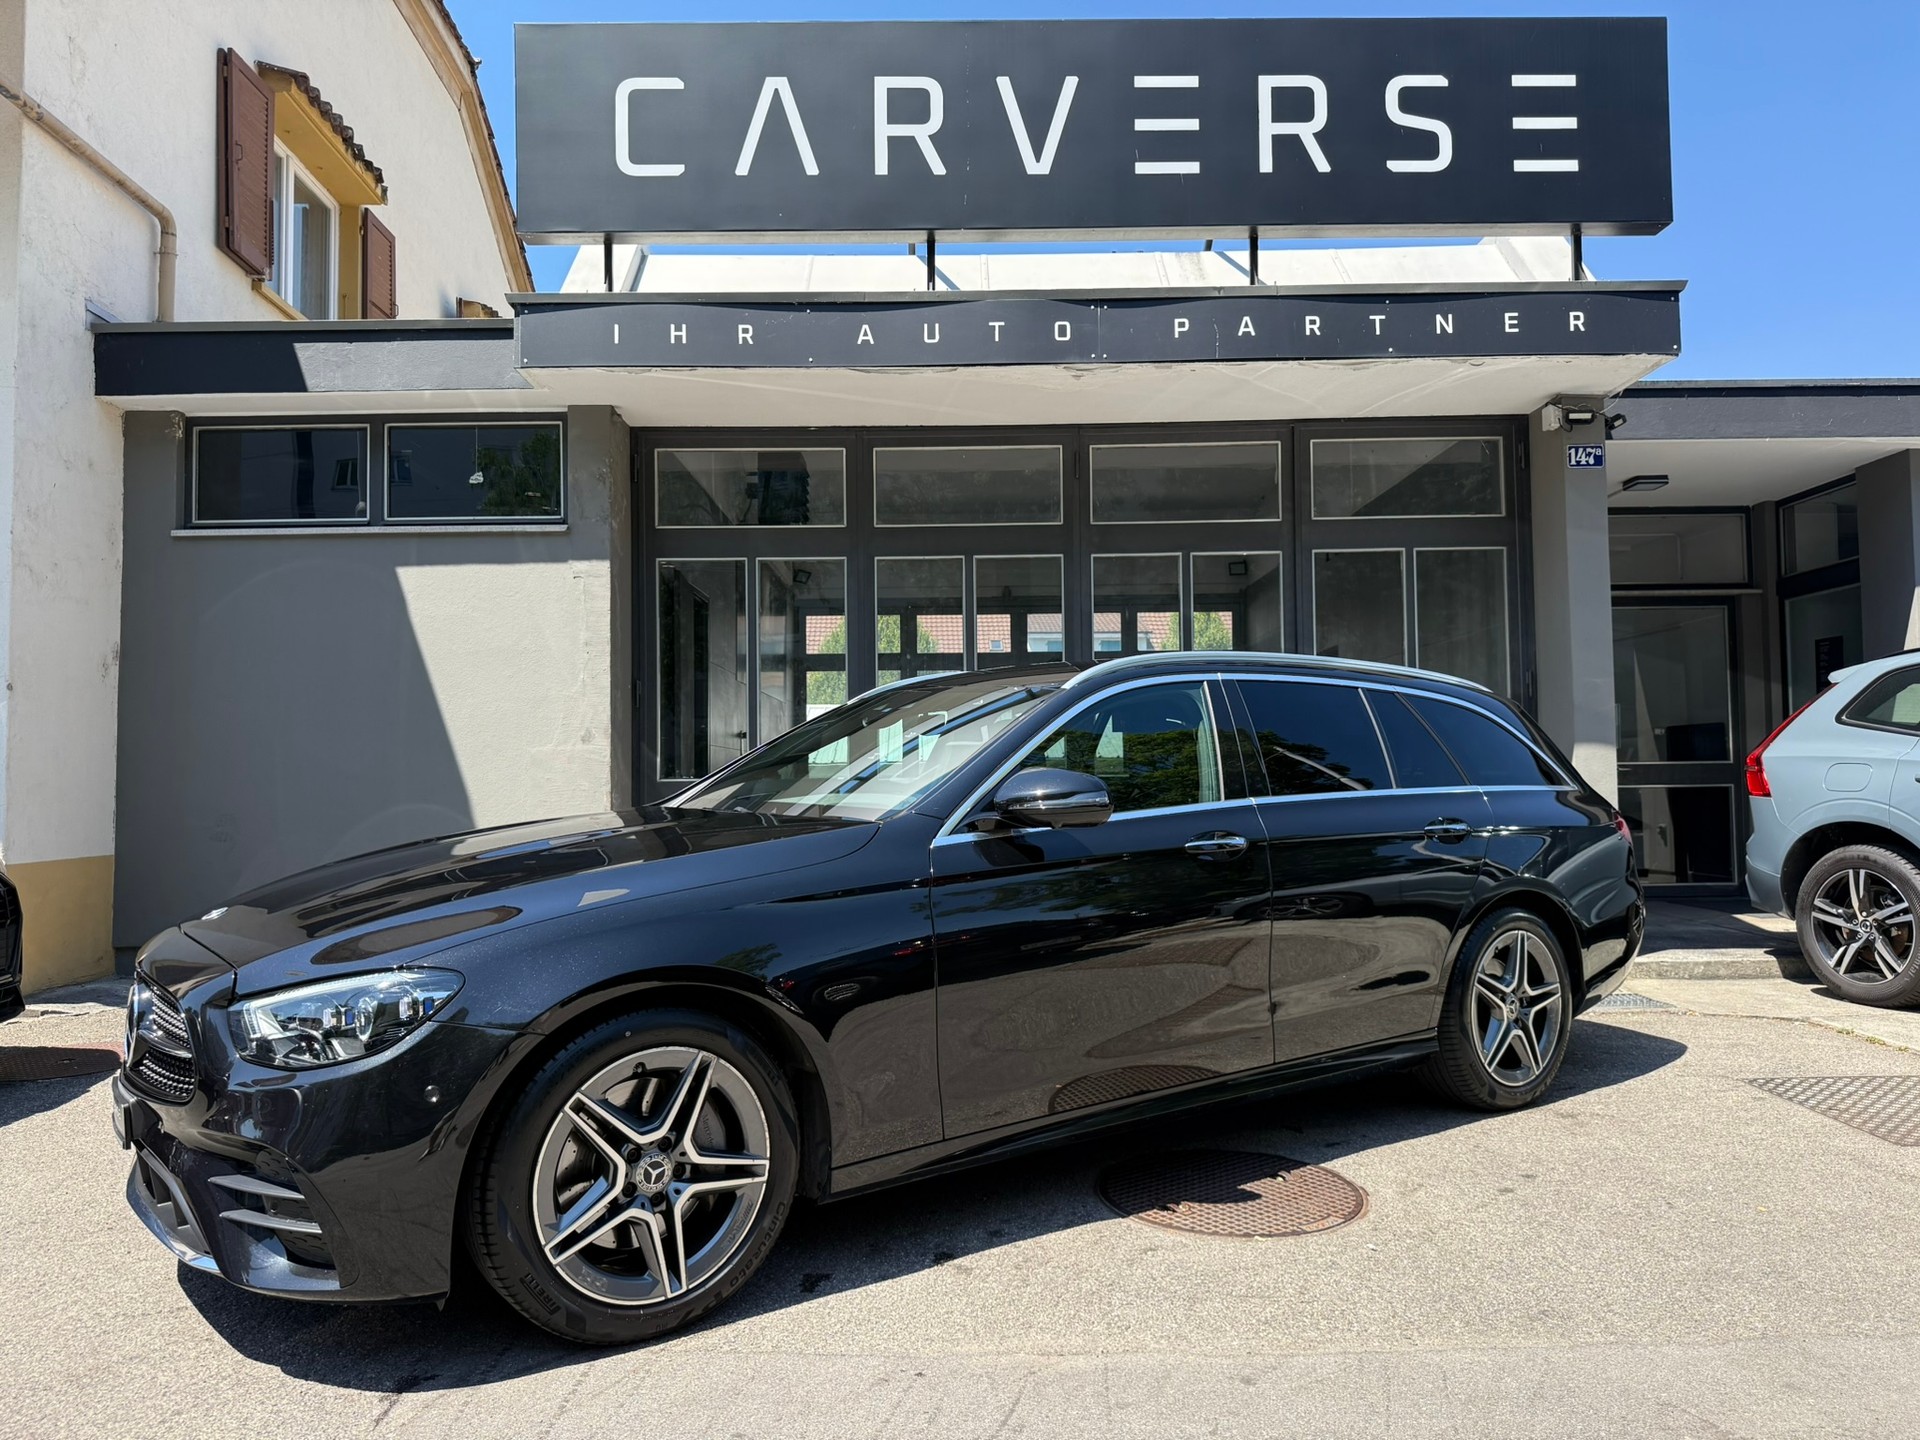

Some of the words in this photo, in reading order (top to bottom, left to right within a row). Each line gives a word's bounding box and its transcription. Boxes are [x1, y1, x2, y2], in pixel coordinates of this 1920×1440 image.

[614, 75, 1580, 177] CARVERSE
[613, 322, 754, 346] IHR
[856, 320, 1072, 345] AUTO
[1173, 311, 1587, 338] PARTNER
[520, 1271, 562, 1315] PIRELLI
